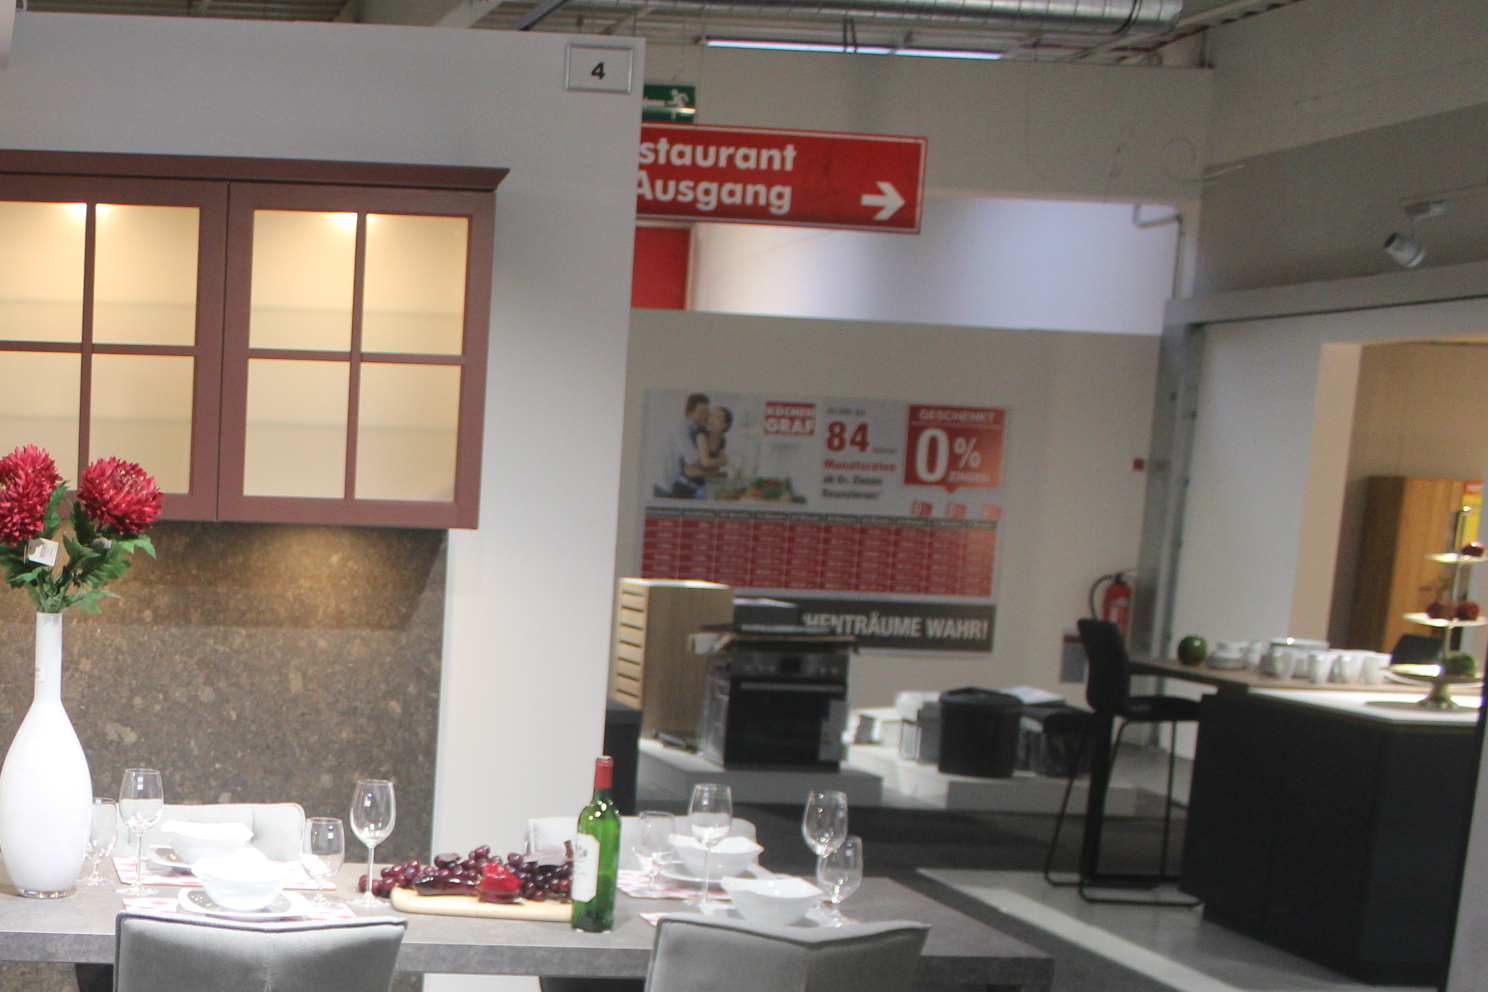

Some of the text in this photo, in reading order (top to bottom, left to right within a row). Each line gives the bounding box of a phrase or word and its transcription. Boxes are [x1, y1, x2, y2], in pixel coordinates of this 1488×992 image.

[591, 62, 606, 80] 4
[636, 169, 793, 216] Ausgang
[765, 417, 814, 434] GRAF
[826, 421, 870, 453] 84
[802, 611, 989, 641] HENTRÄUME WAHR!
